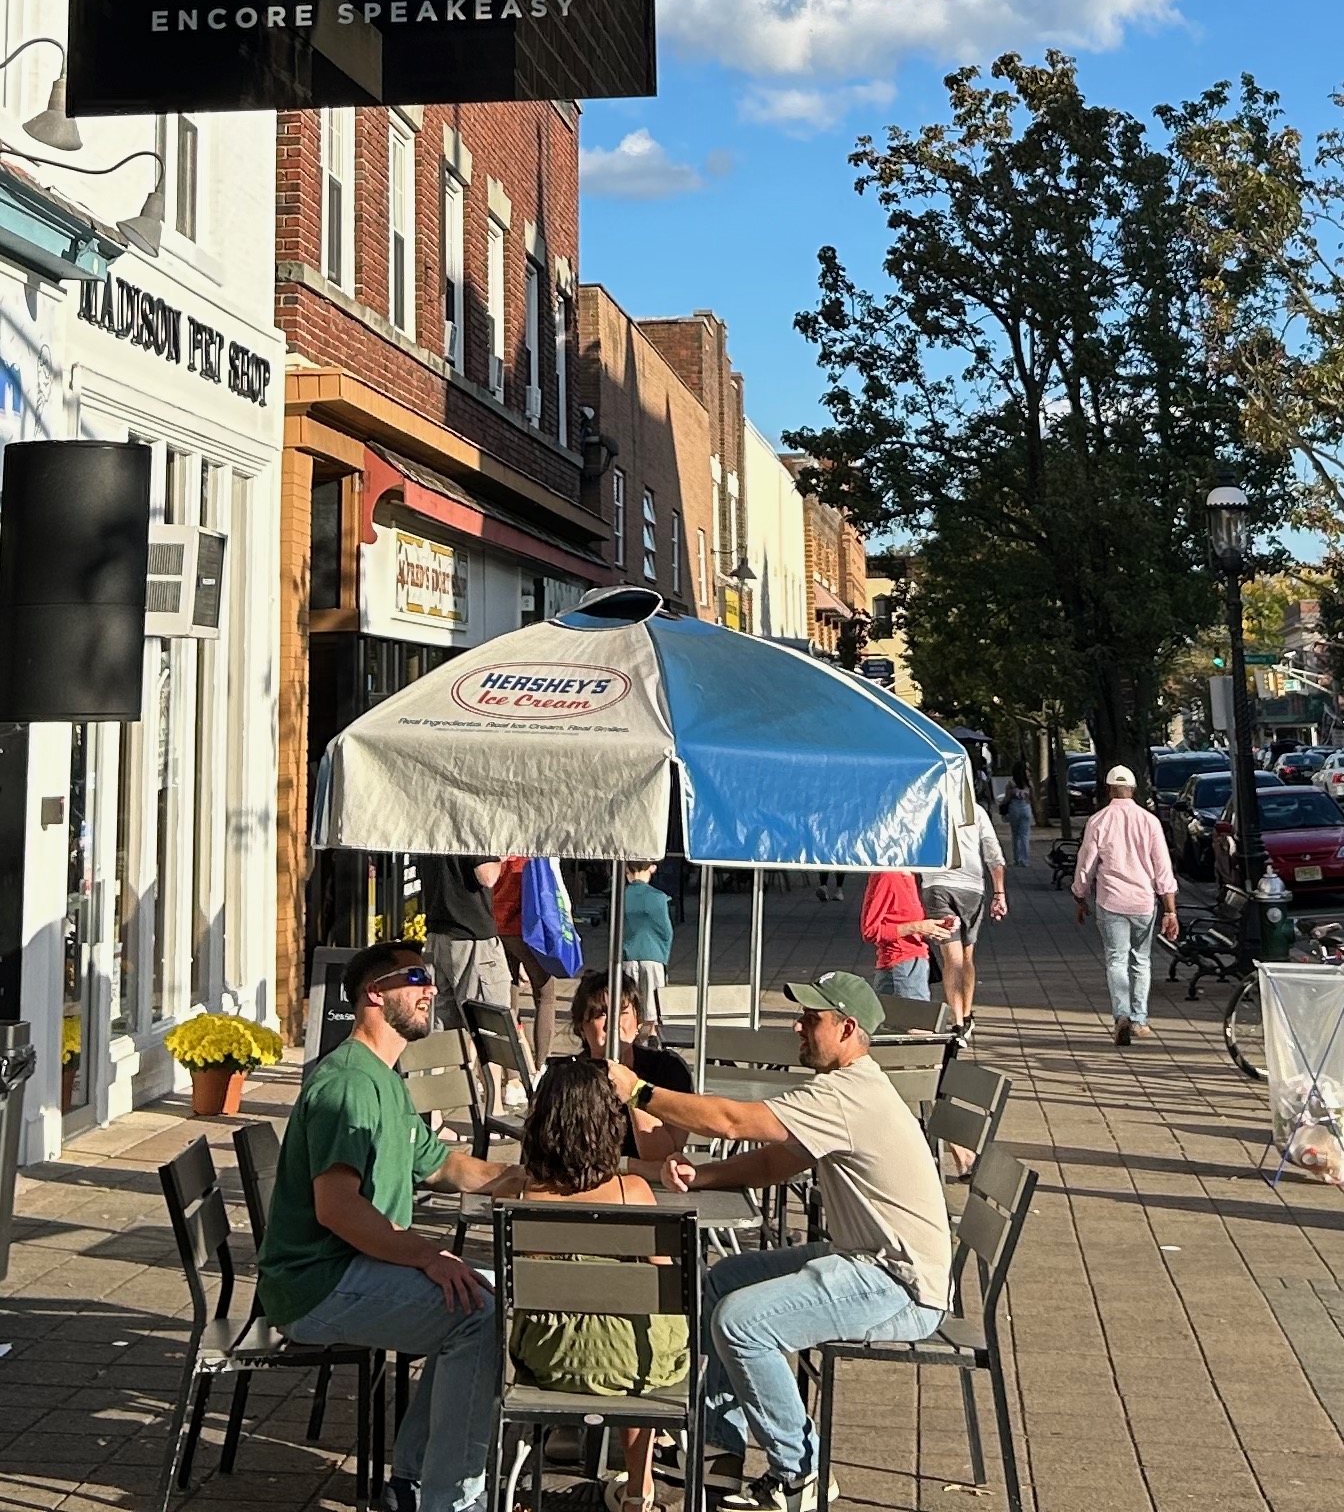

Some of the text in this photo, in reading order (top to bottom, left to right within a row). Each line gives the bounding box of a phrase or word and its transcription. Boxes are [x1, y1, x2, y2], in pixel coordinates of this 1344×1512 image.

[151, 3, 314, 32] ENCORE
[187, 314, 225, 385] PET
[228, 340, 271, 407] SHOP
[480, 672, 612, 695] HERSHEY'S
[477, 690, 591, 710] Ice Cream
